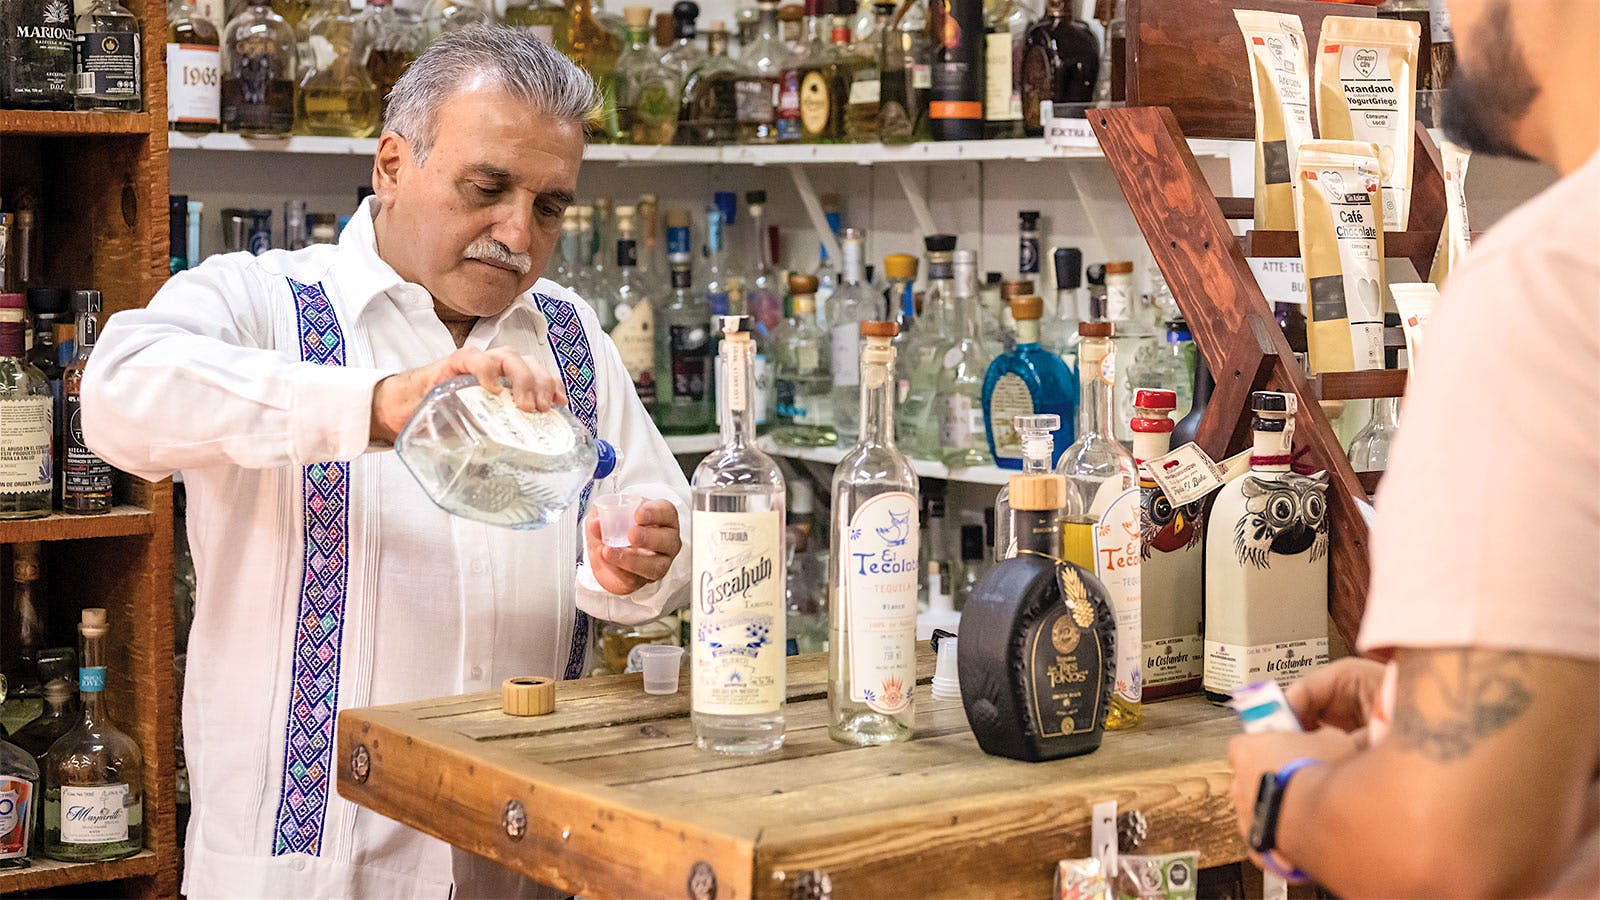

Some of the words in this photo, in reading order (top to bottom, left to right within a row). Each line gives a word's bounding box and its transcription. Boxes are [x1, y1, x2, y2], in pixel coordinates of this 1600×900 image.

[183, 64, 218, 87] 1965
[1343, 84, 1395, 93] Arandano
[1346, 97, 1398, 107] YogurtGriego
[1339, 209, 1364, 223] Café
[1336, 225, 1377, 237] Chocolate
[1262, 261, 1288, 273] ATTE:
[1155, 651, 1189, 668] Costumbre
[1275, 655, 1313, 672] Costumbre
